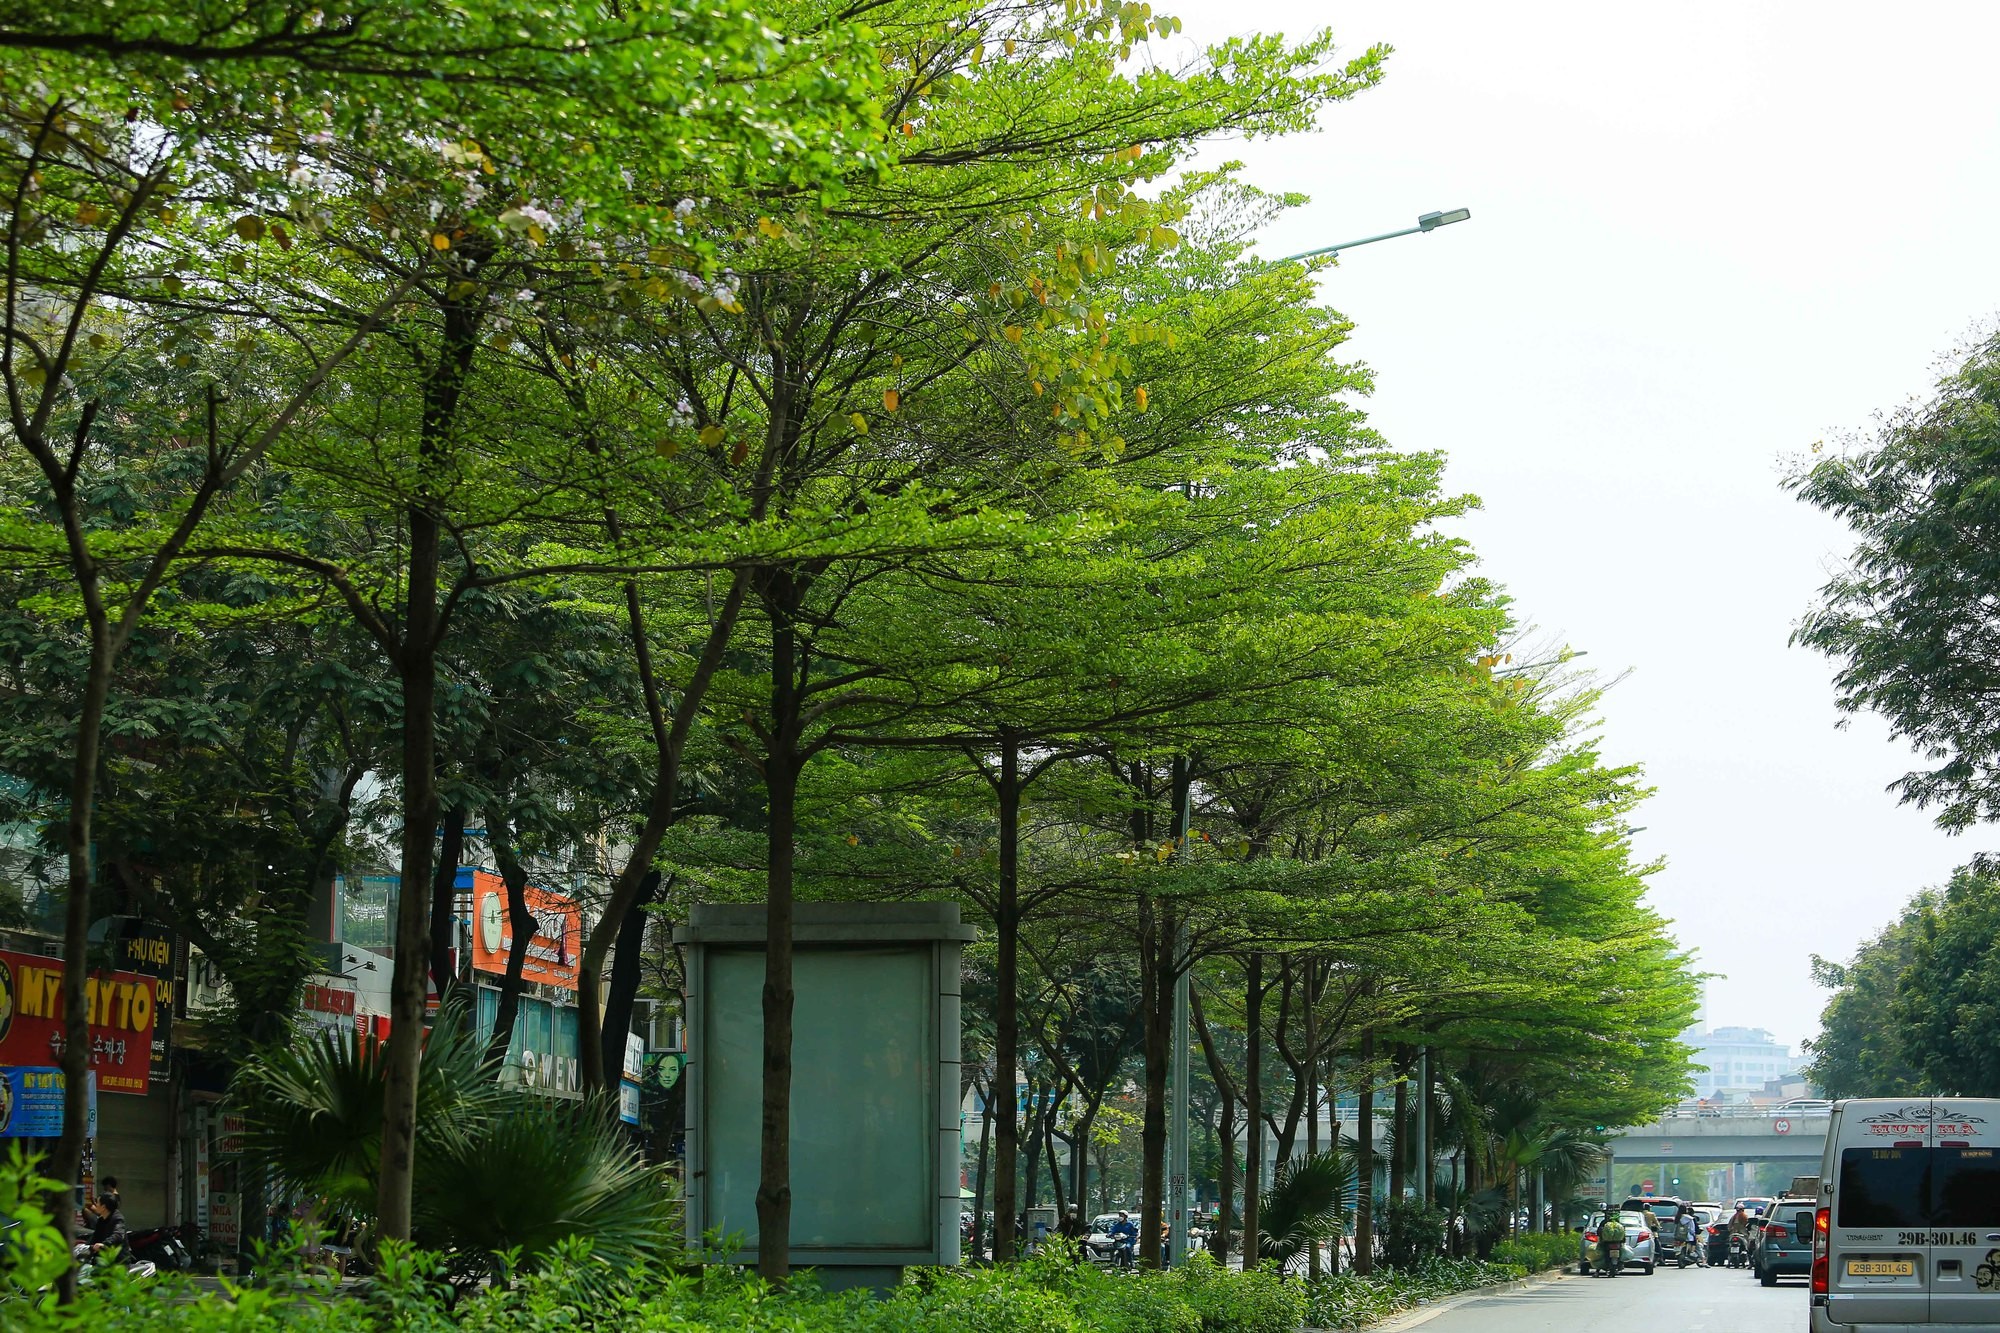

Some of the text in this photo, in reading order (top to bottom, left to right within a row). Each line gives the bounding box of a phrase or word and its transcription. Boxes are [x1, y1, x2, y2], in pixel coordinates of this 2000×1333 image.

[156, 979, 173, 1008] OẠI
[117, 982, 150, 1032] TO
[522, 1050, 577, 1093] OWEN
[1870, 1124, 1928, 1134] HUY
[1898, 1231, 1977, 1246] 29B-301.46
[1853, 1264, 1908, 1273] 29B-301.46
